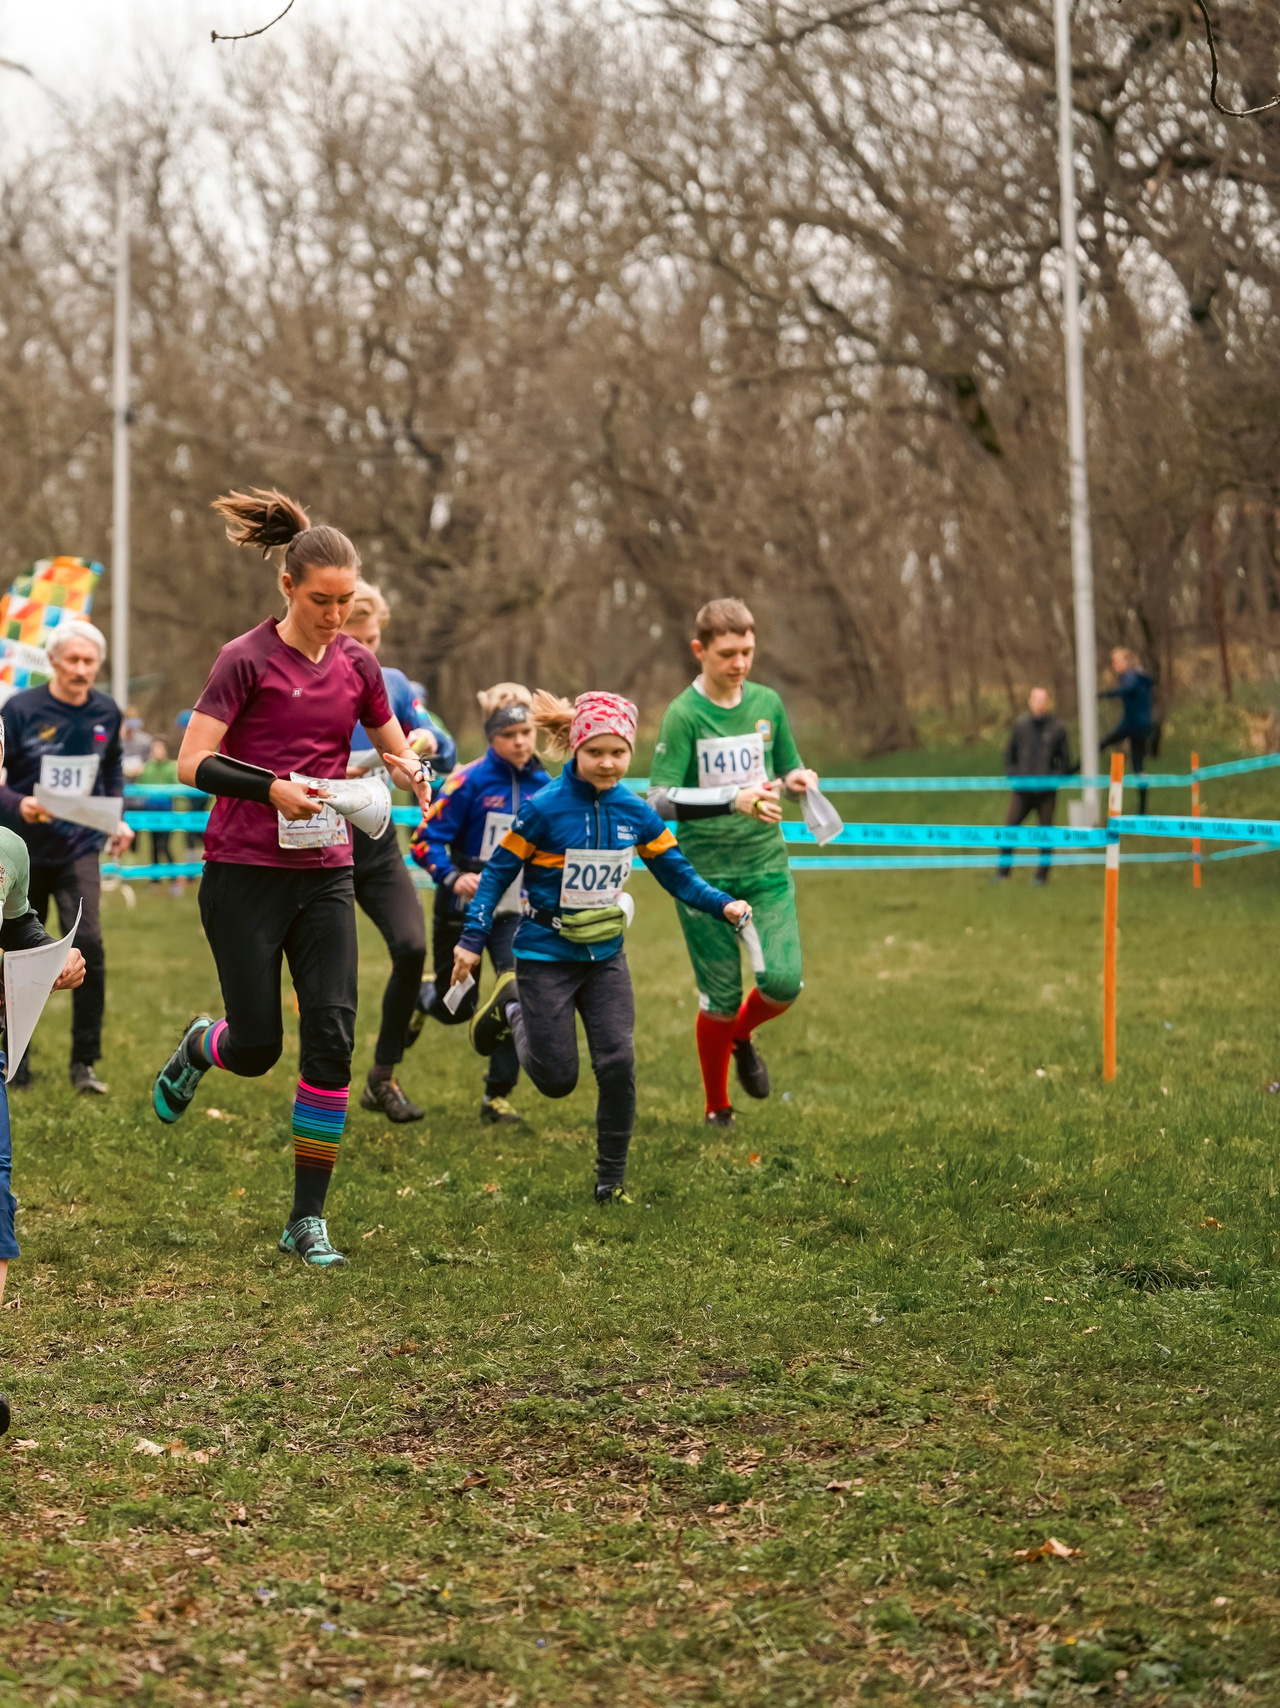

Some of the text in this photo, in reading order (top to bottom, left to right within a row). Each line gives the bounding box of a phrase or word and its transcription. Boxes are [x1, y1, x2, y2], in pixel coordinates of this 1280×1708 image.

[702, 748, 751, 773] 1410
[50, 768, 81, 788] 381
[565, 863, 622, 891] 2024
